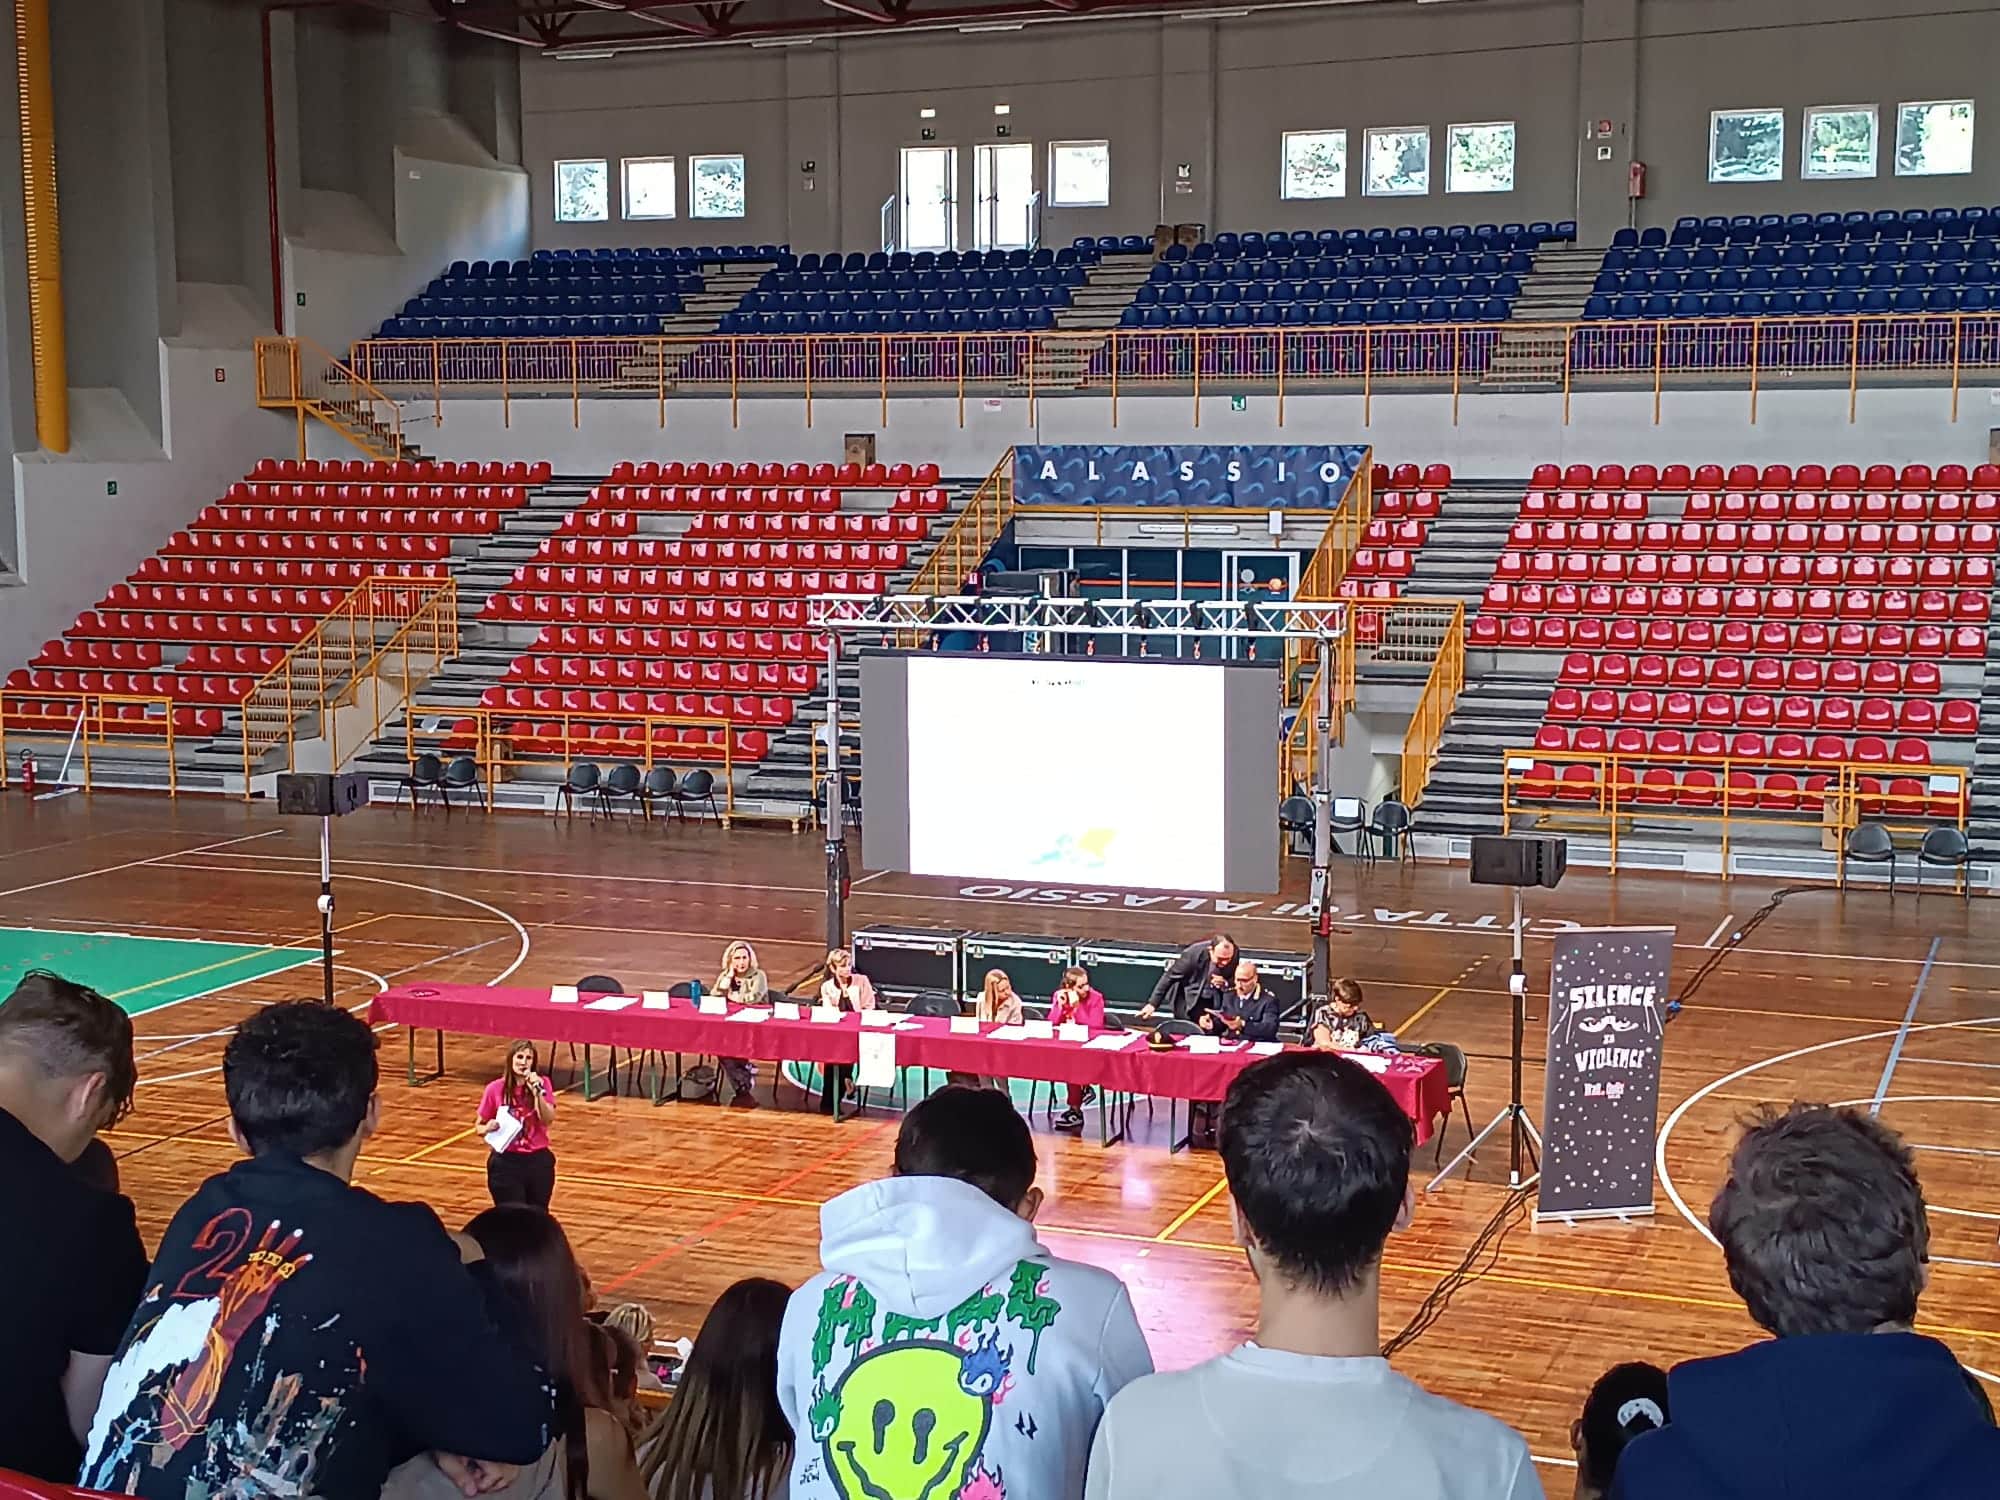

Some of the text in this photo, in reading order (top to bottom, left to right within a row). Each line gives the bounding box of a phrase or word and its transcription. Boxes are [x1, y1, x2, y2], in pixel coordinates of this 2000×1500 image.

[1040, 460, 1341, 483] ALASSIO
[959, 885, 1263, 912] ALASSIO
[1569, 985, 1656, 1013] SILENCE
[1574, 1047, 1645, 1072] VIOLENCE
